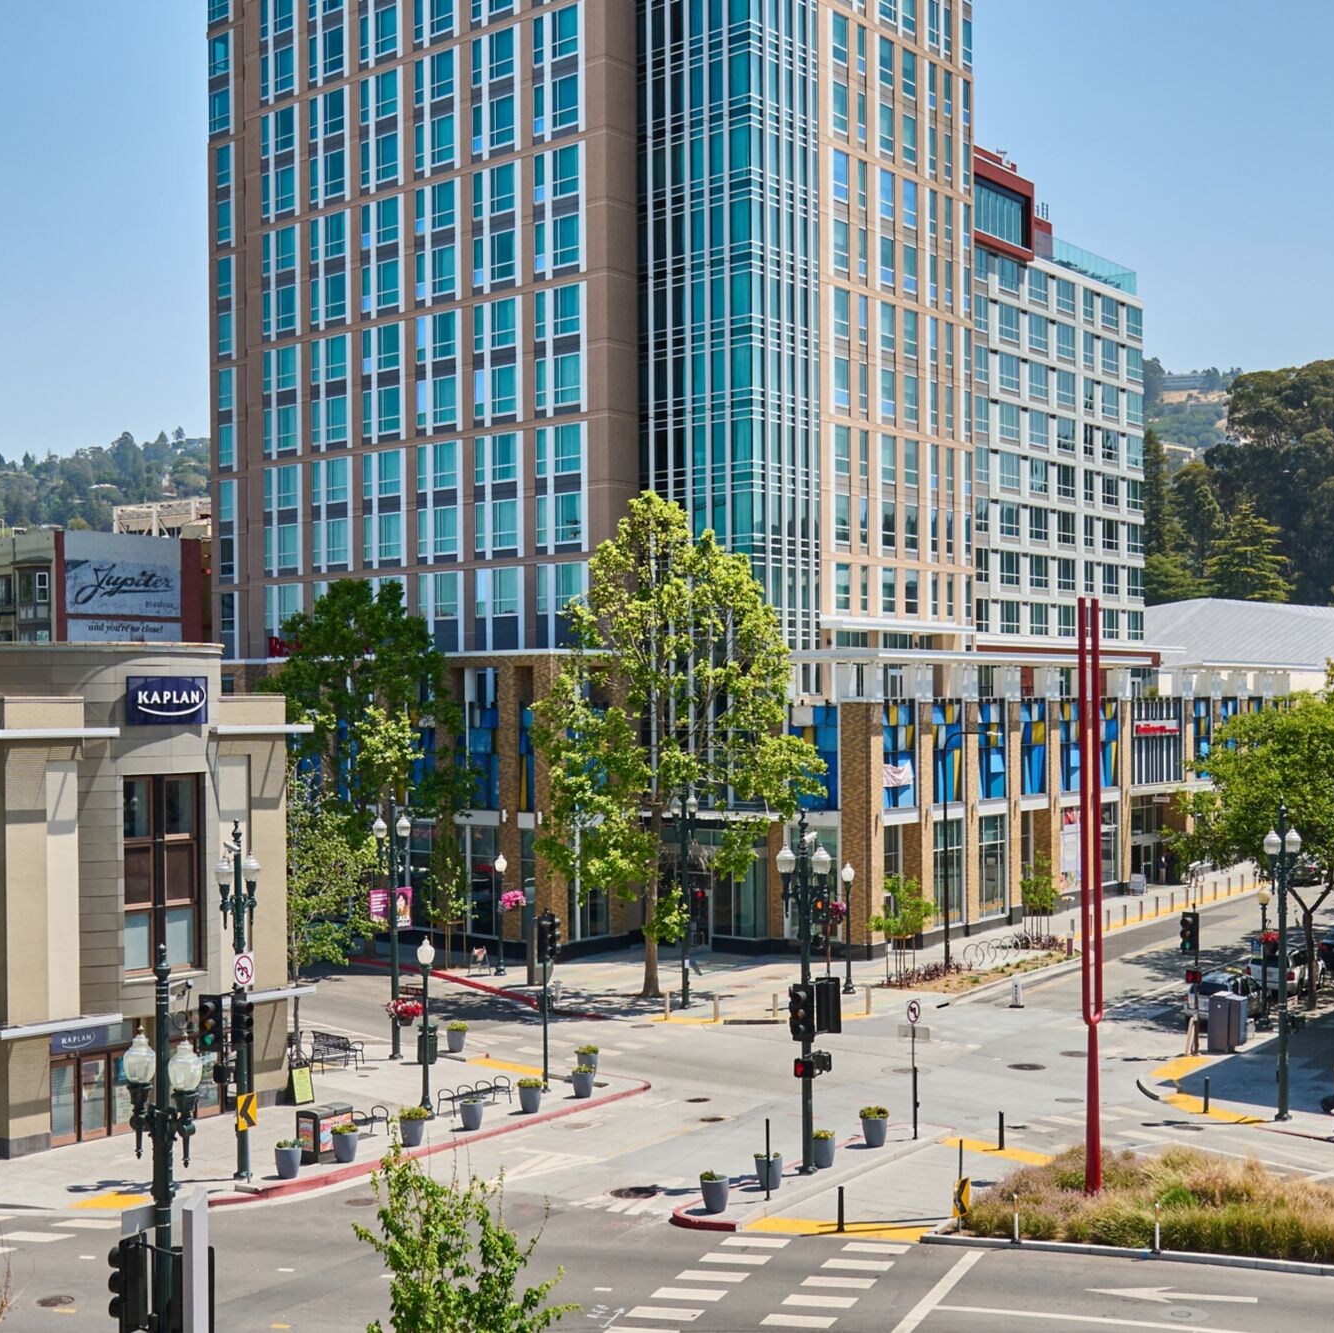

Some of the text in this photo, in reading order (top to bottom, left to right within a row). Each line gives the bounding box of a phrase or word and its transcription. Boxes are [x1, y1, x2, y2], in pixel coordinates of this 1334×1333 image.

[75, 563, 173, 605] Jupiter
[88, 623, 104, 632] and
[138, 690, 200, 704] KAPLAN
[61, 1033, 92, 1045] KAPLAN
